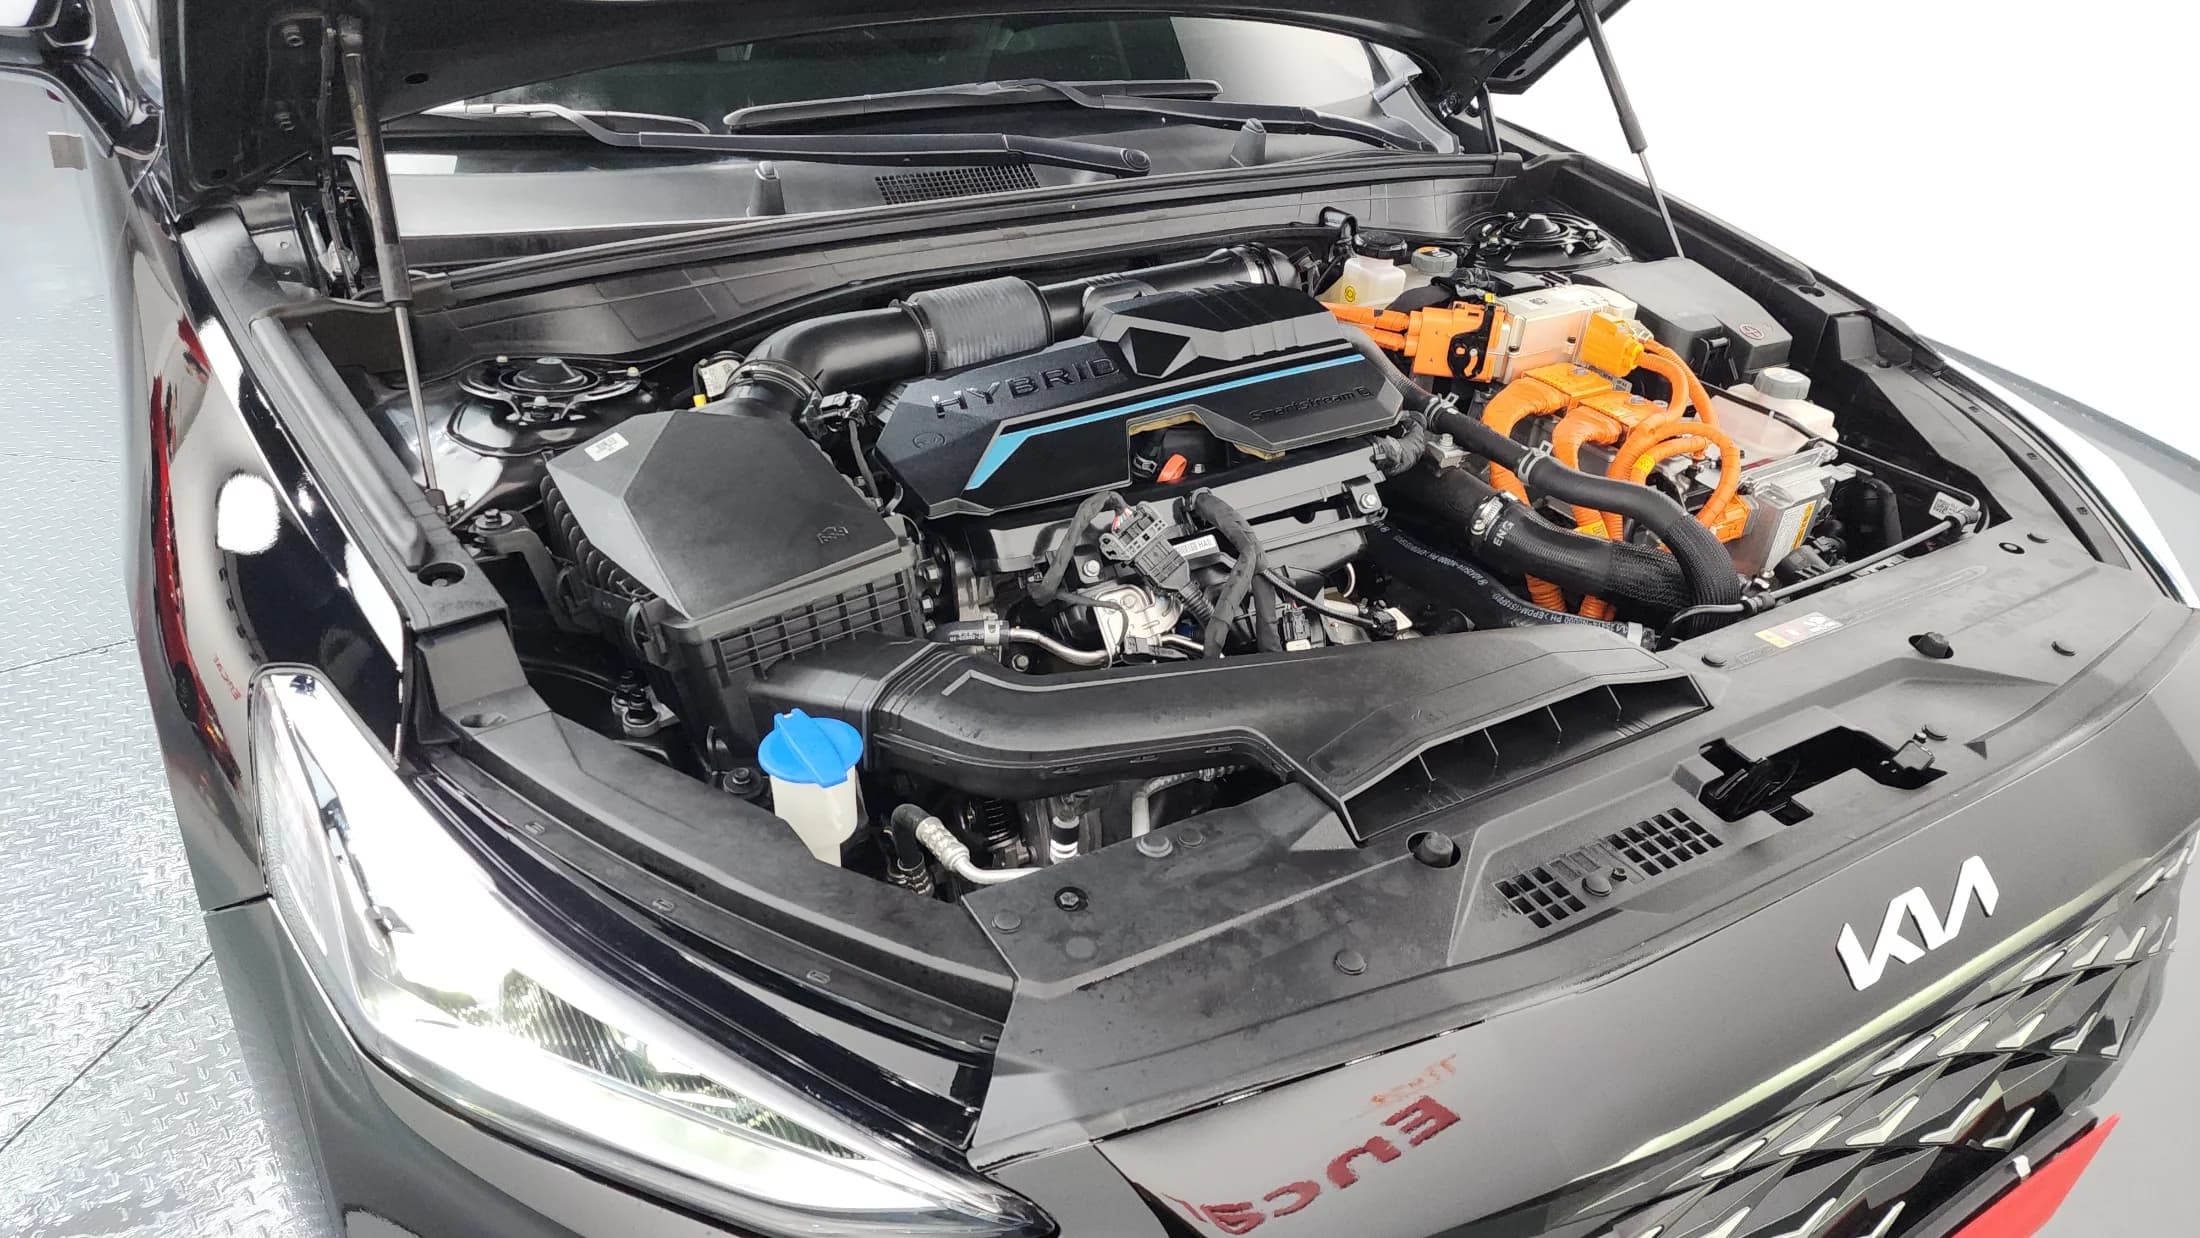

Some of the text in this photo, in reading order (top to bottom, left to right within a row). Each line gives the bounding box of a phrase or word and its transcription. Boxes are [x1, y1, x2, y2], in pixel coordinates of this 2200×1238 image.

[931, 358, 1120, 418] HYBRID
[1249, 391, 1355, 422] Smartstream
[1493, 519, 1515, 547] ENG
[1835, 855, 1999, 991] KIA
